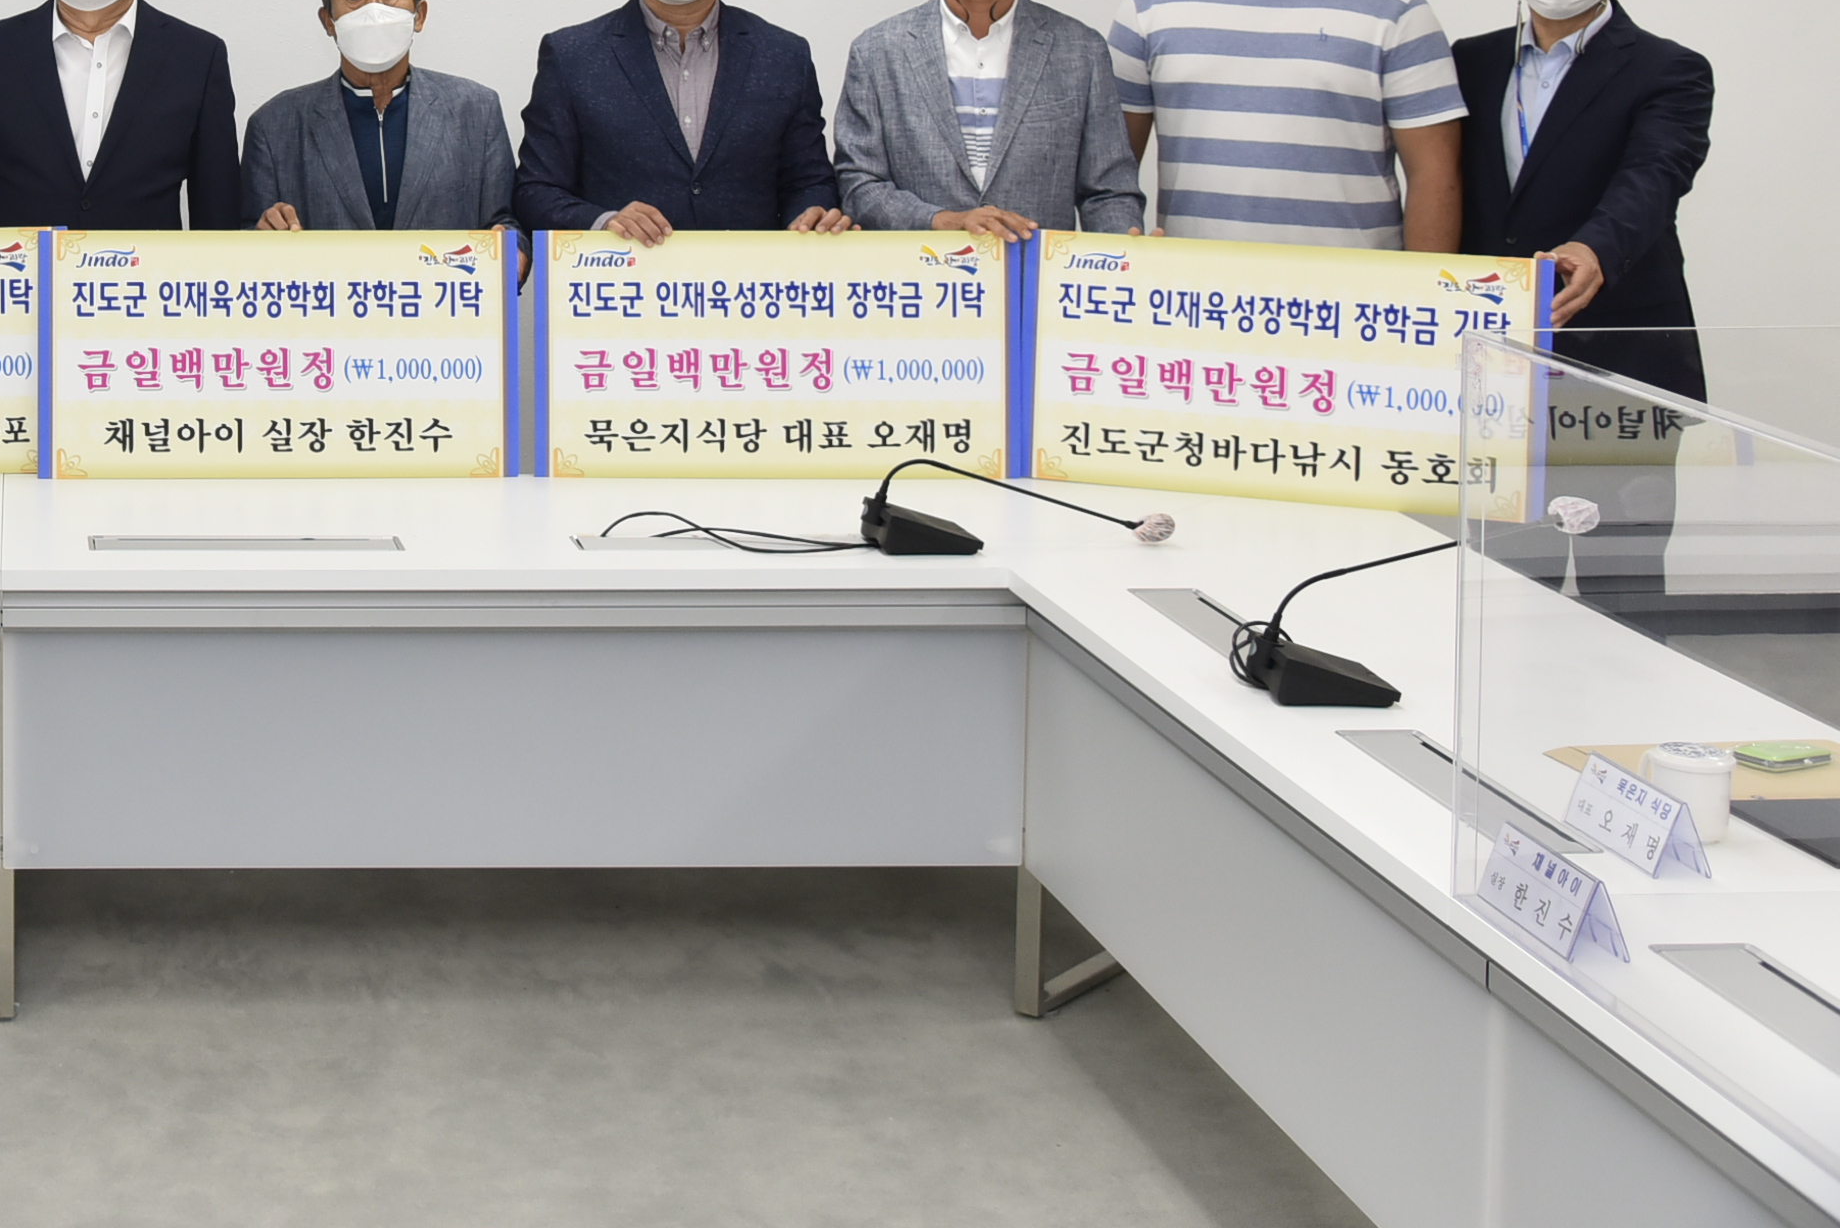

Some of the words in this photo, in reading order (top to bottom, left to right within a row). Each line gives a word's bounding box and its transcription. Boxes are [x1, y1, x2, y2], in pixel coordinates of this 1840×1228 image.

[76, 253, 128, 269] Jindo
[572, 253, 626, 269] Jindo
[1064, 254, 1119, 272] Jindo
[72, 282, 147, 318] 진도군
[160, 280, 336, 318] 인재육성장학회
[347, 280, 422, 318] 장학금
[434, 280, 483, 318] 기탁
[568, 281, 644, 318] 진도군
[656, 280, 835, 319] 인재육성장학회
[847, 280, 923, 319] 장학금
[935, 280, 985, 318] 기탁
[1058, 282, 1137, 324] 진도군
[1149, 288, 1341, 339] 인재육성장학회
[1354, 301, 1439, 346] 장학금
[1454, 310, 1511, 343] 기탁
[78, 346, 336, 392] 금일백만원정
[574, 346, 835, 392] 금일백만원정
[1061, 351, 1337, 417] 금일백만원정
[104, 417, 245, 454] 채널아이
[262, 417, 333, 453] 실장
[346, 417, 454, 453] 한진수
[584, 417, 768, 454] 묵은지식당
[783, 418, 852, 453] 대표
[868, 417, 973, 454] 오재명
[1061, 422, 1362, 482] 진도군청바다낚시
[1381, 449, 1497, 494] 동호회
[1616, 777, 1648, 807] 묵은지
[1650, 797, 1673, 820] 식당
[1531, 852, 1583, 897] 채널아이
